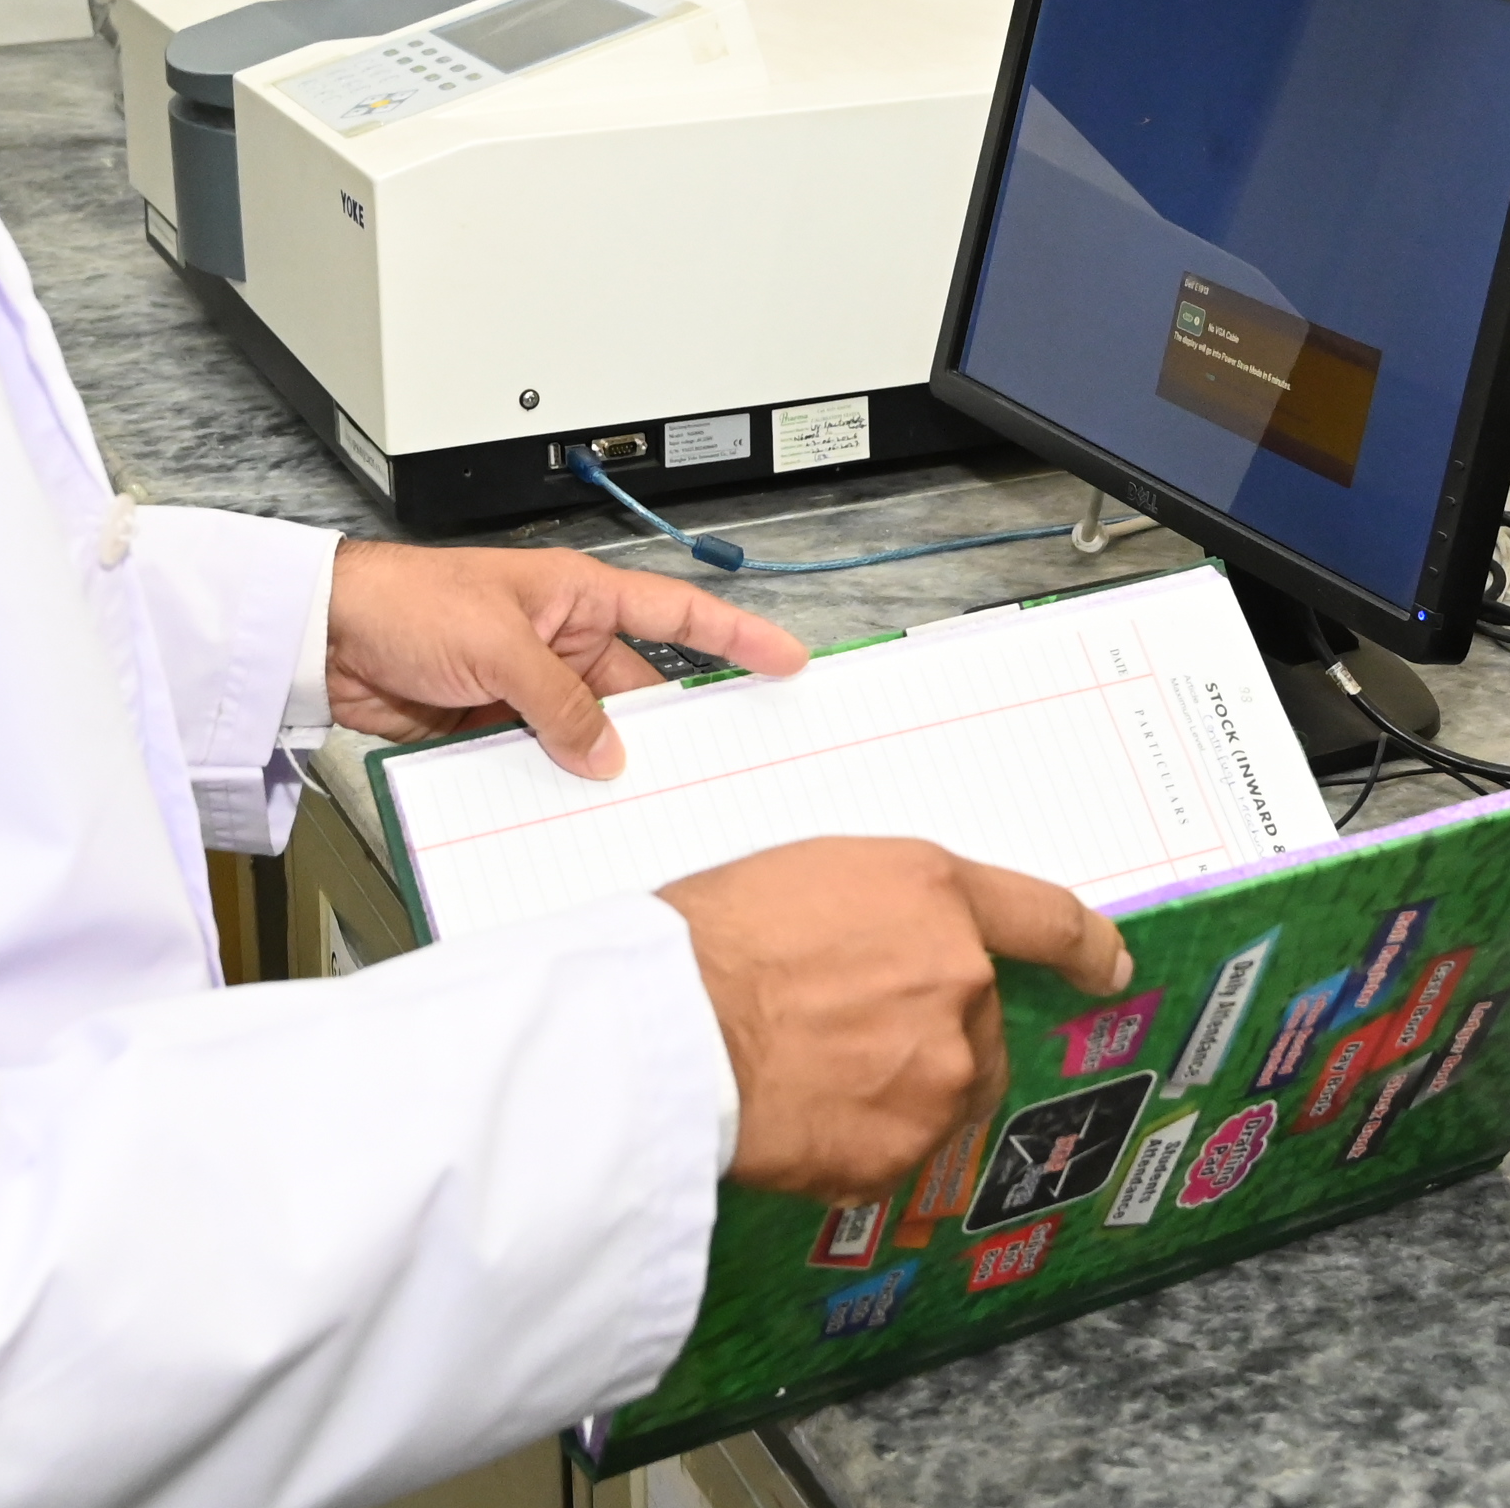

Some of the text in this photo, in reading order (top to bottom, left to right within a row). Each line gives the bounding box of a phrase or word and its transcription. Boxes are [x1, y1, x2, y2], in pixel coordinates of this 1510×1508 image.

[341, 189, 364, 229] YOKE
[1184, 278, 1195, 289] Dell
[1174, 331, 1182, 342] The
[1182, 334, 1198, 350] display
[1198, 343, 1206, 352] will
[1206, 347, 1212, 356] go
[1212, 348, 1221, 359] into
[1221, 352, 1237, 366] Power
[1237, 359, 1249, 371] Save
[1249, 365, 1262, 378] Mode
[1262, 371, 1268, 380] in
[1208, 323, 1240, 344] No VGA Cable
[1110, 647, 1129, 677] DATE
[1184, 674, 1199, 705] Article
[1170, 677, 1206, 752] Maximum Level
[1135, 709, 1189, 826] PARTICULARS
[1205, 682, 1240, 744] STOCK
[1231, 749, 1278, 837] (INWARD
[1354, 944, 1401, 1008] Register
[1395, 960, 1456, 1048] Cash Book
[1105, 1014, 1142, 1057] Ring
[1183, 959, 1254, 1078] Daily Attendance
[1429, 1001, 1493, 1092] Ledger Book
[1309, 1041, 1363, 1117] Day Book
[1346, 1073, 1408, 1160] Stock Book
[1112, 1139, 1163, 1220] Attendance
[1139, 1140, 1181, 1204] Students
[1198, 1143, 1232, 1178] Pad
[1211, 1117, 1265, 1187] Drafting
[973, 1248, 1003, 1282] Book
[997, 1240, 1025, 1272] Note
[1016, 1222, 1052, 1274] Subject
